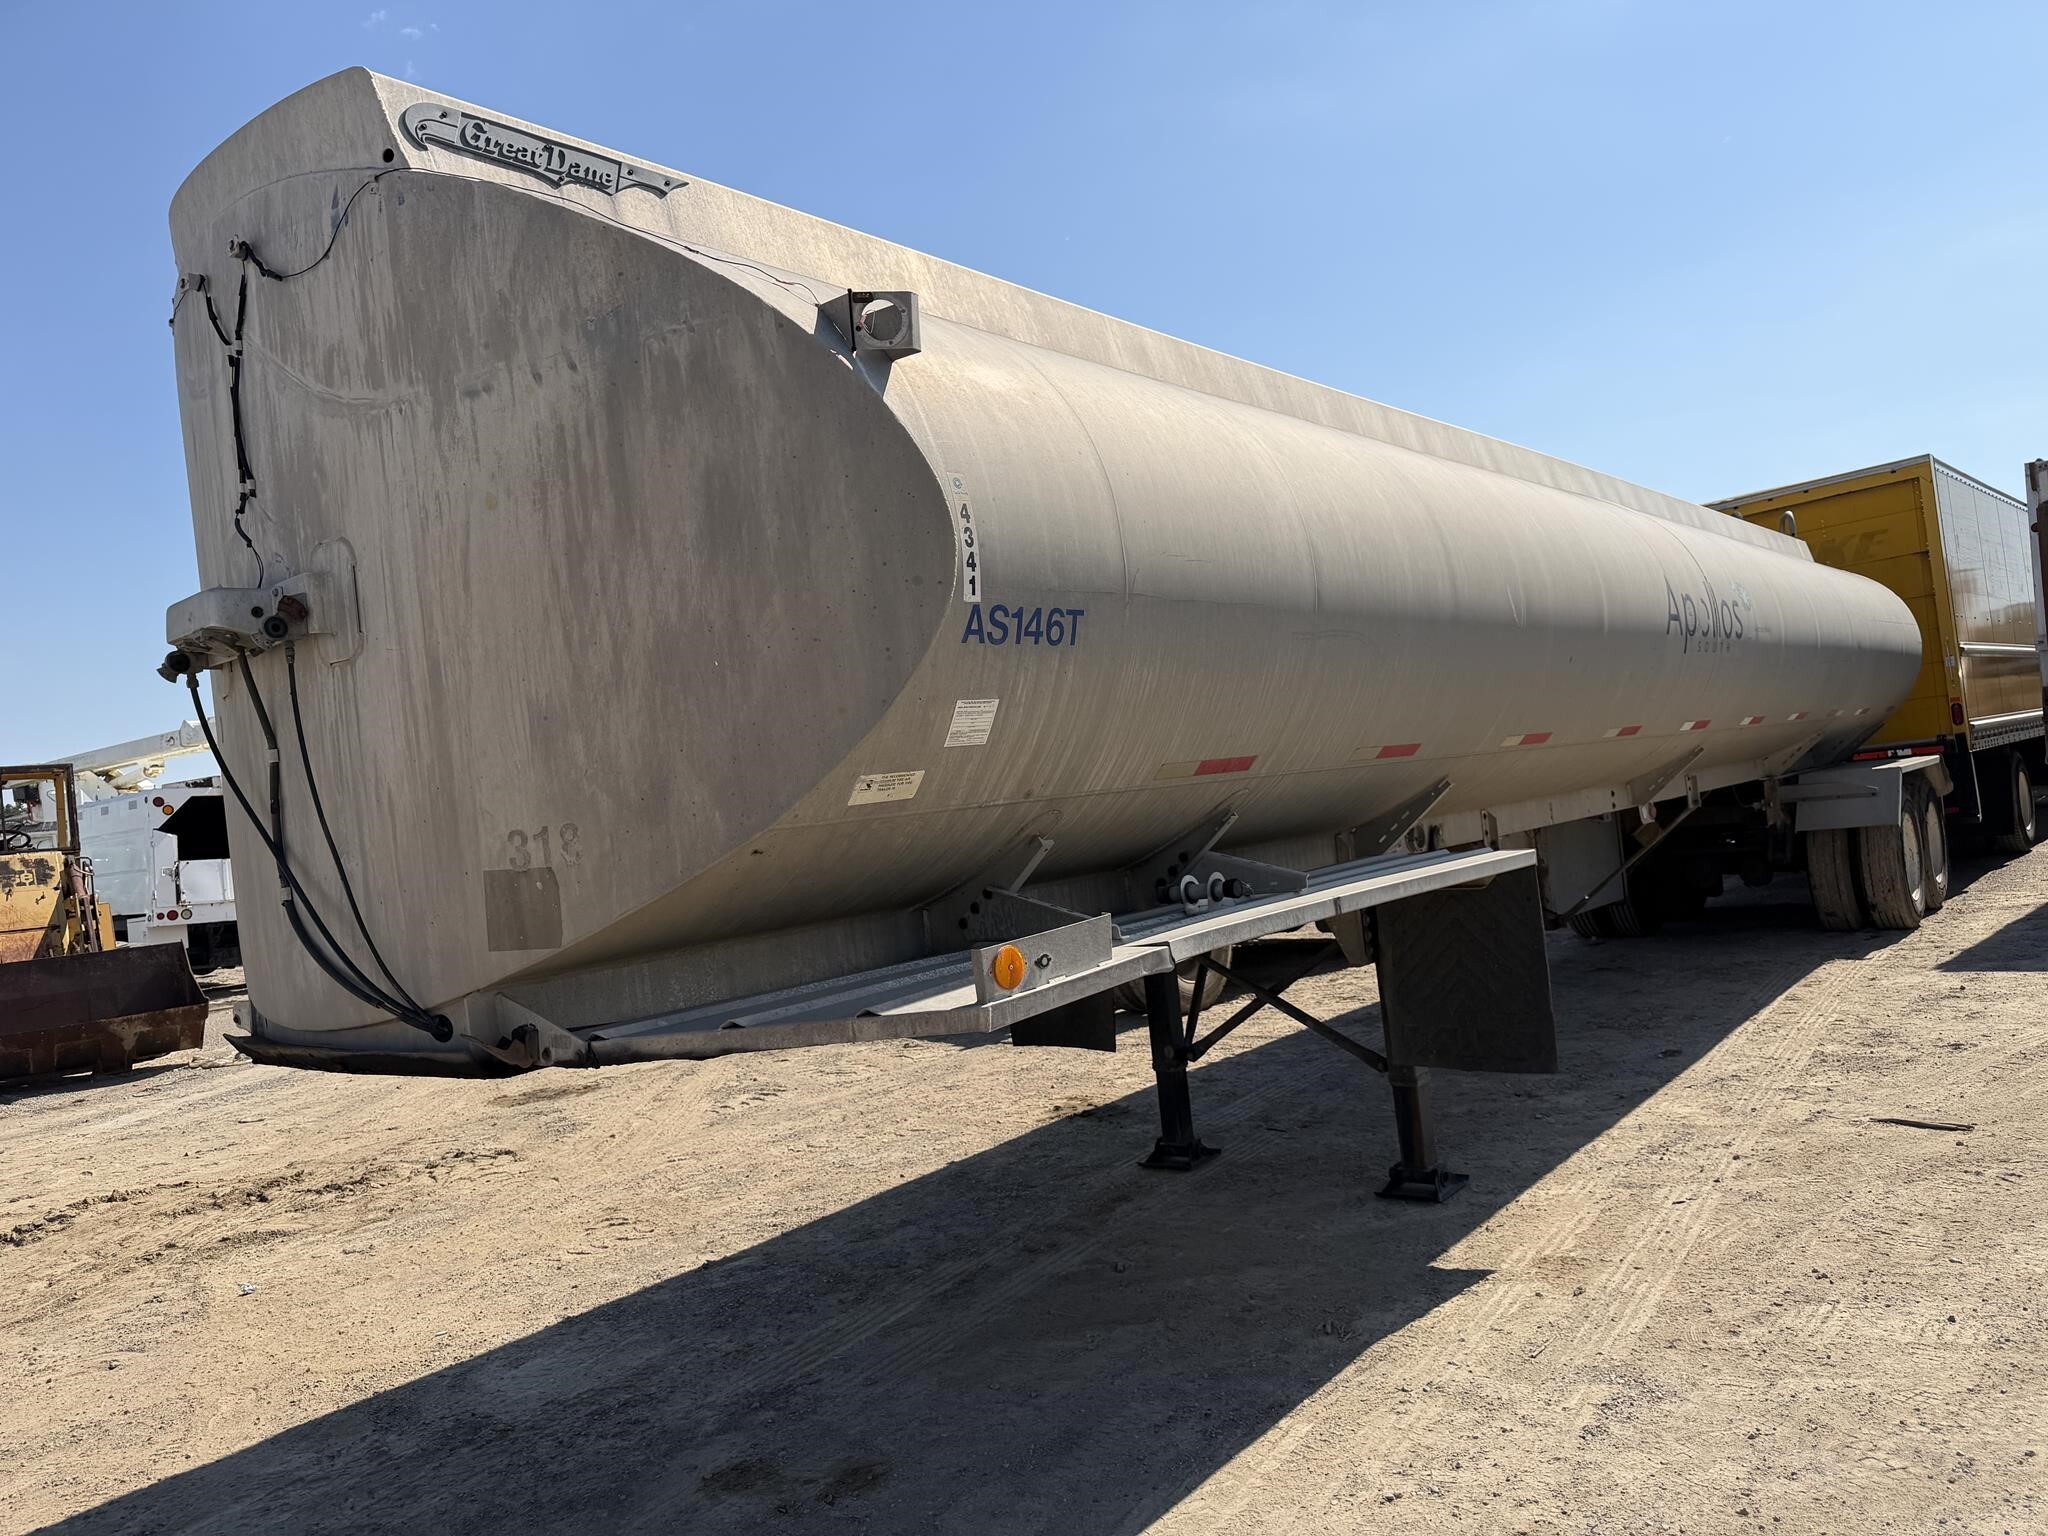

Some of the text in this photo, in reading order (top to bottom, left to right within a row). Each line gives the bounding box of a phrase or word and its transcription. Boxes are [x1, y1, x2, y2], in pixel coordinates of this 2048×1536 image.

[459, 119, 618, 189] Great Dane
[960, 503, 977, 597] 4341
[961, 603, 1085, 647] AS146T
